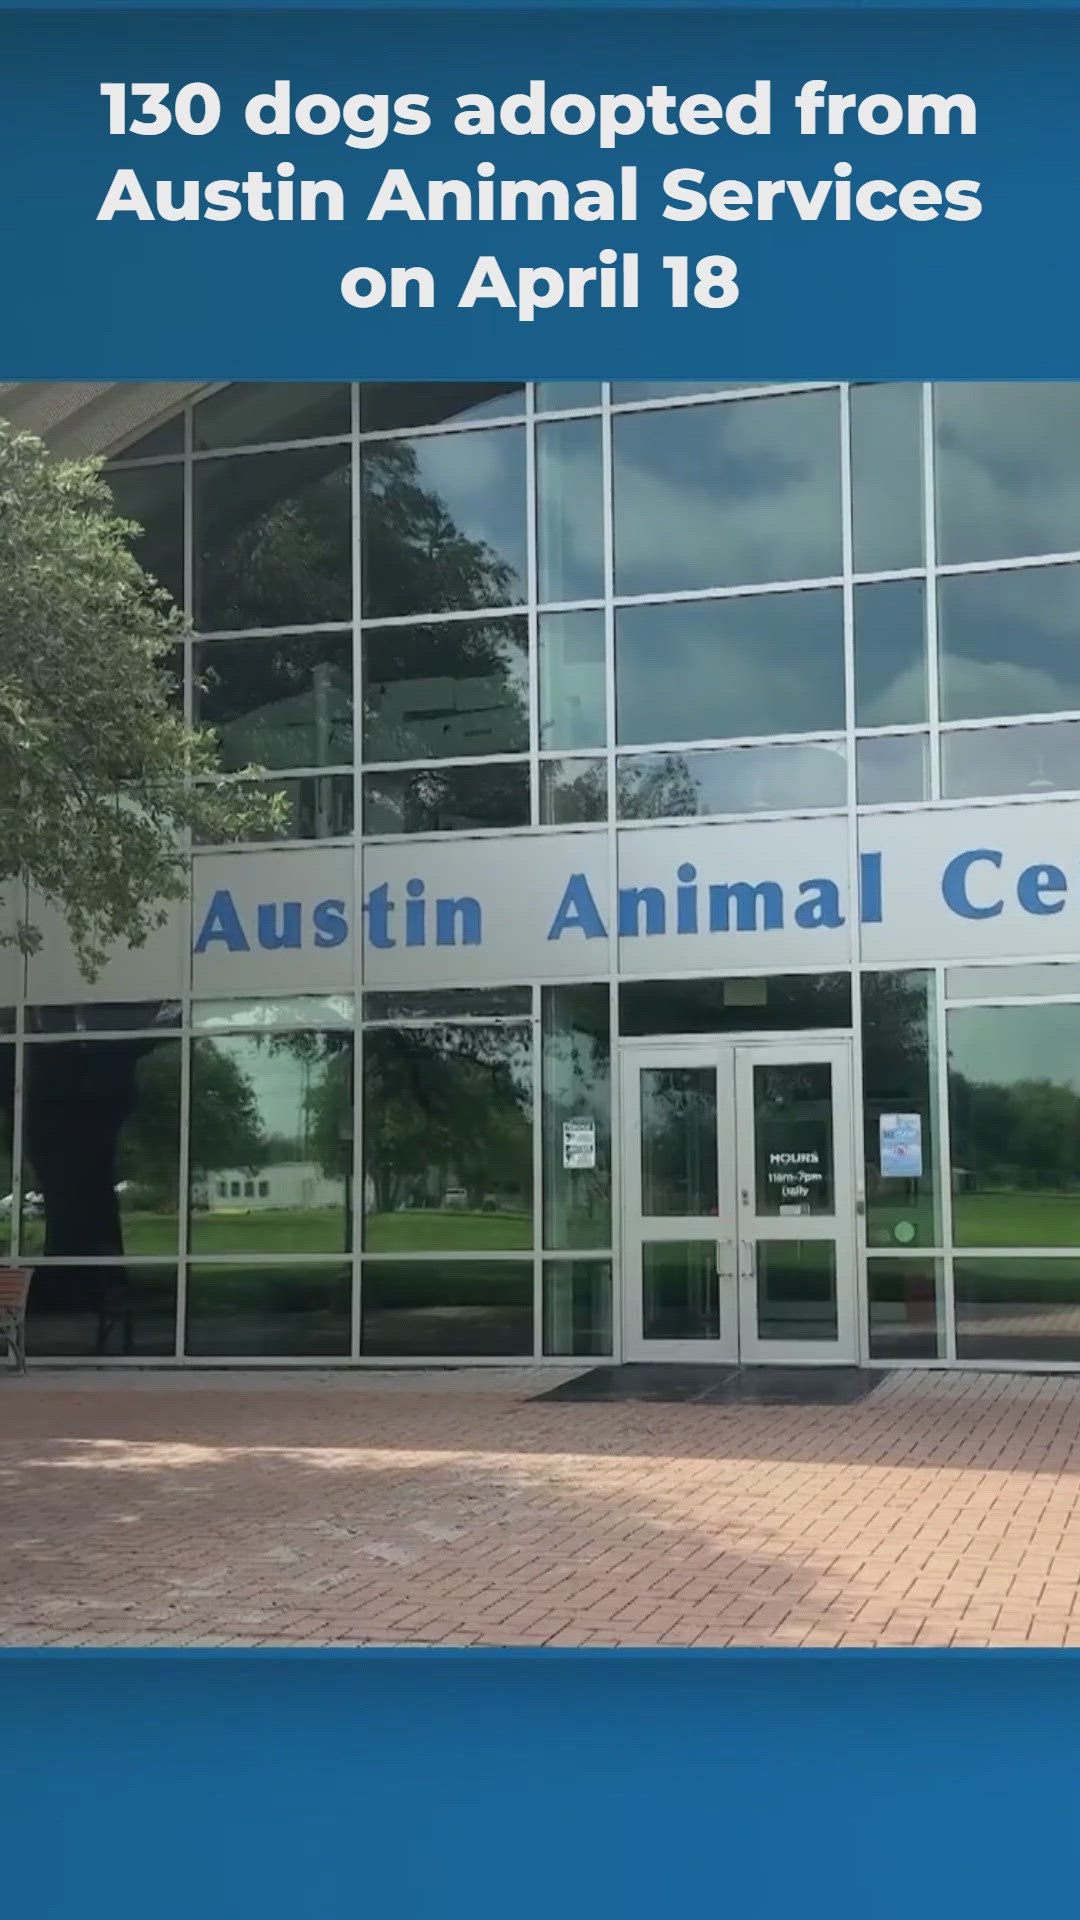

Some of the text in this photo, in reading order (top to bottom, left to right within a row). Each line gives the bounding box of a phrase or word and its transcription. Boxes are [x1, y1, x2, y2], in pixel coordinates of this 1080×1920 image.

[194, 878, 484, 953] Austin
[547, 853, 883, 942] Animal
[769, 1152, 819, 1164] HOURS
